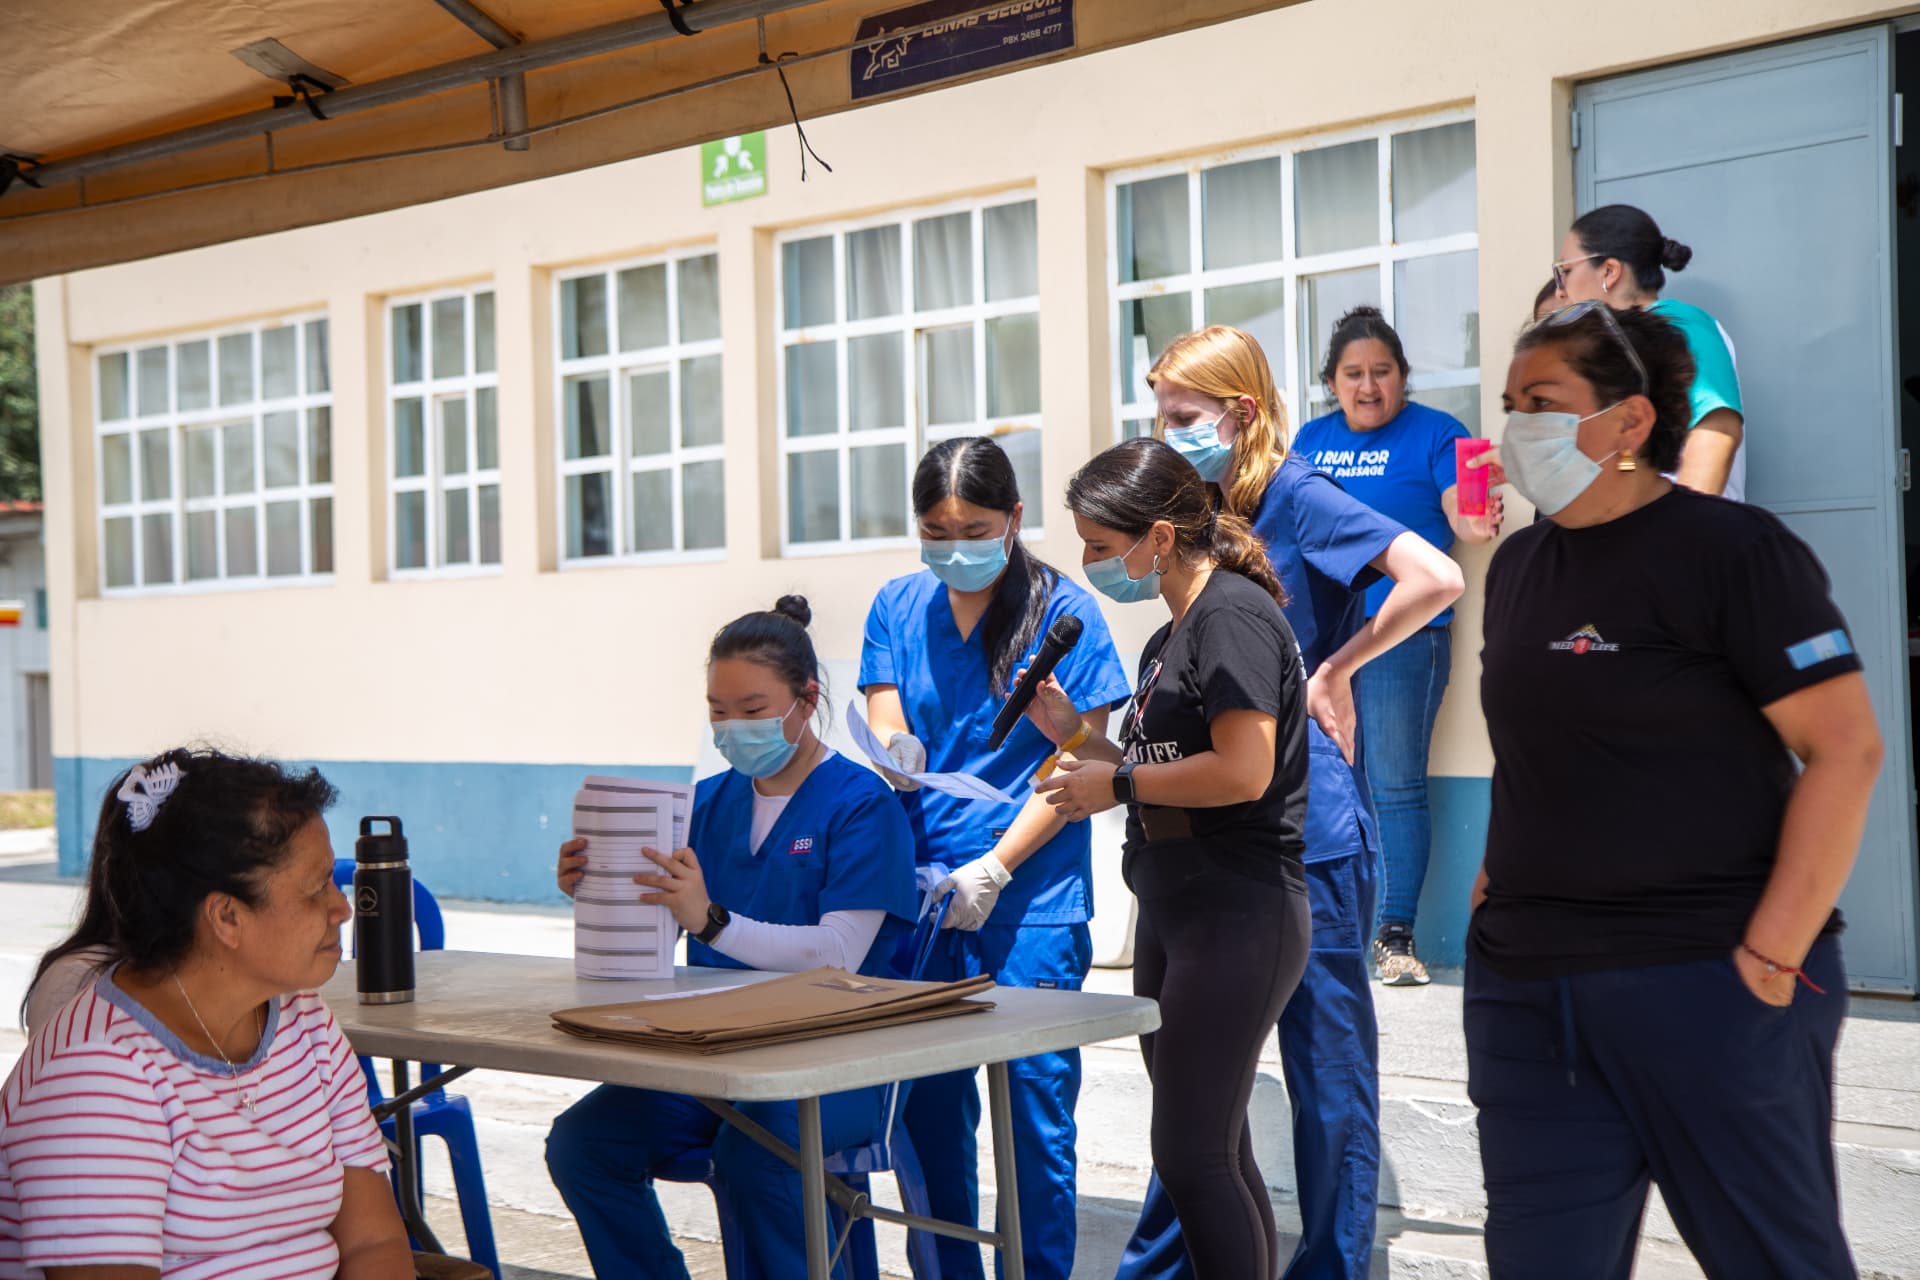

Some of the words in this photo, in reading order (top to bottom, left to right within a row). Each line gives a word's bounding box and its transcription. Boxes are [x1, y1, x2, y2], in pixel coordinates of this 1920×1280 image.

[1002, 35, 1020, 46] PBX
[1043, 23, 1063, 35] 4777
[1314, 451, 1323, 465] I
[1322, 450, 1355, 466] RUN
[1357, 449, 1390, 465] FOR
[1335, 465, 1386, 478] PASSAGE
[1549, 641, 1574, 650] MED
[1591, 642, 1620, 651] LIFE
